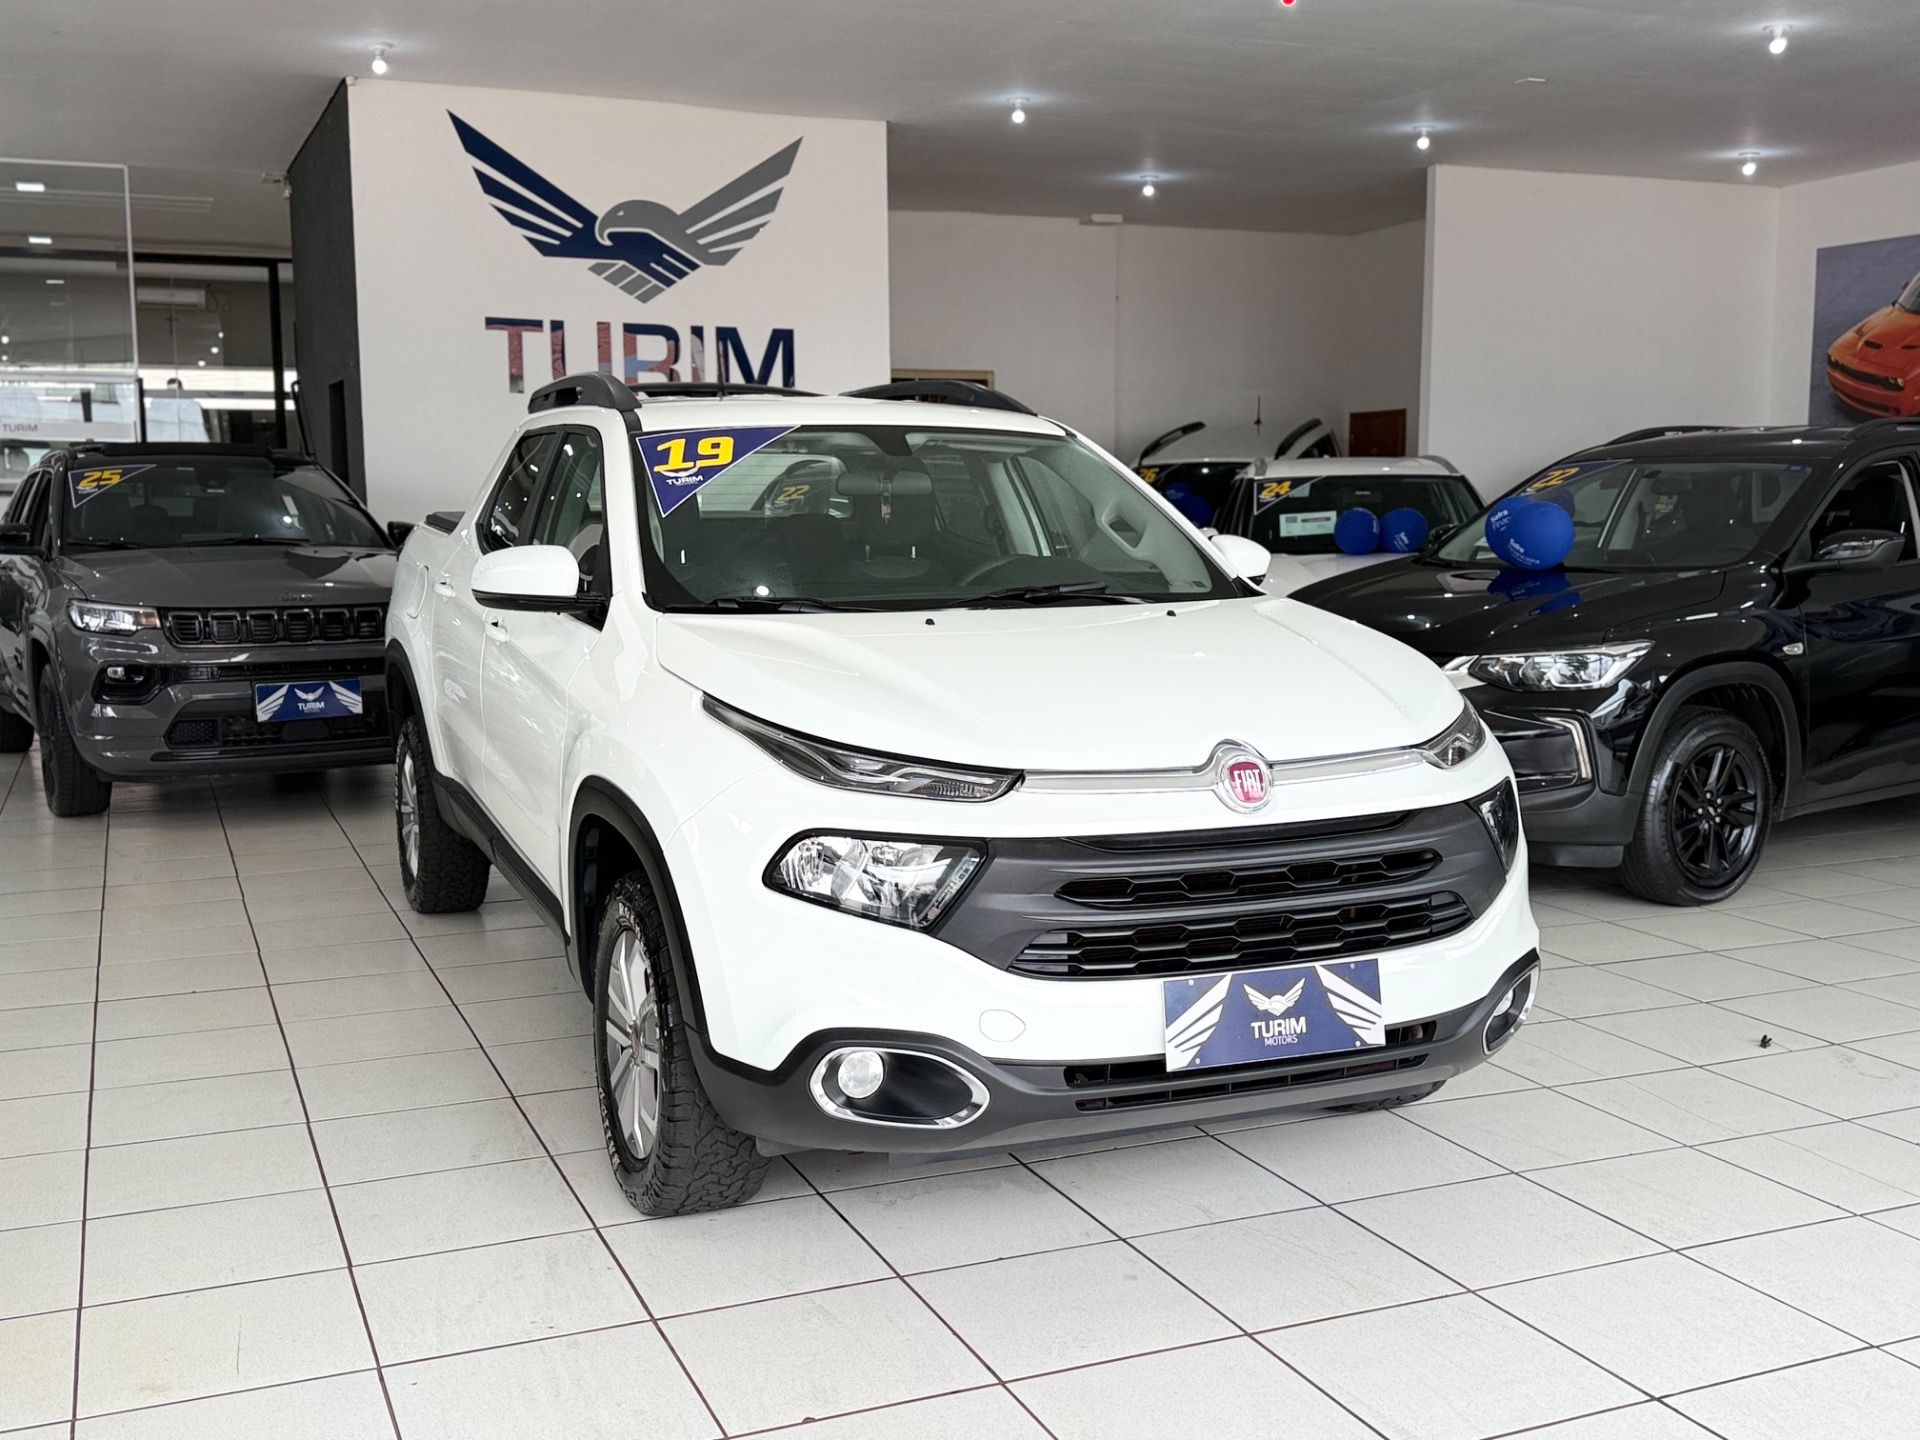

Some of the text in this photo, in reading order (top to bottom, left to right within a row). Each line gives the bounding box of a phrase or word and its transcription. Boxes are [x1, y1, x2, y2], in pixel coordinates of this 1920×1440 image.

[484, 316, 796, 394] TURIM
[3, 423, 39, 433] TURIM
[653, 436, 734, 472] 19
[78, 469, 122, 489] 25
[665, 474, 704, 486] TURIM
[1530, 467, 1581, 489] 22
[777, 484, 810, 502] 22
[1260, 480, 1292, 497] 24
[1490, 509, 1508, 523] Safra
[1510, 538, 1525, 554] Safra
[297, 701, 325, 711] TURIM
[1232, 768, 1262, 794] FIAT
[1250, 1016, 1307, 1039] TURIM
[1264, 1033, 1298, 1047] MOTORS
